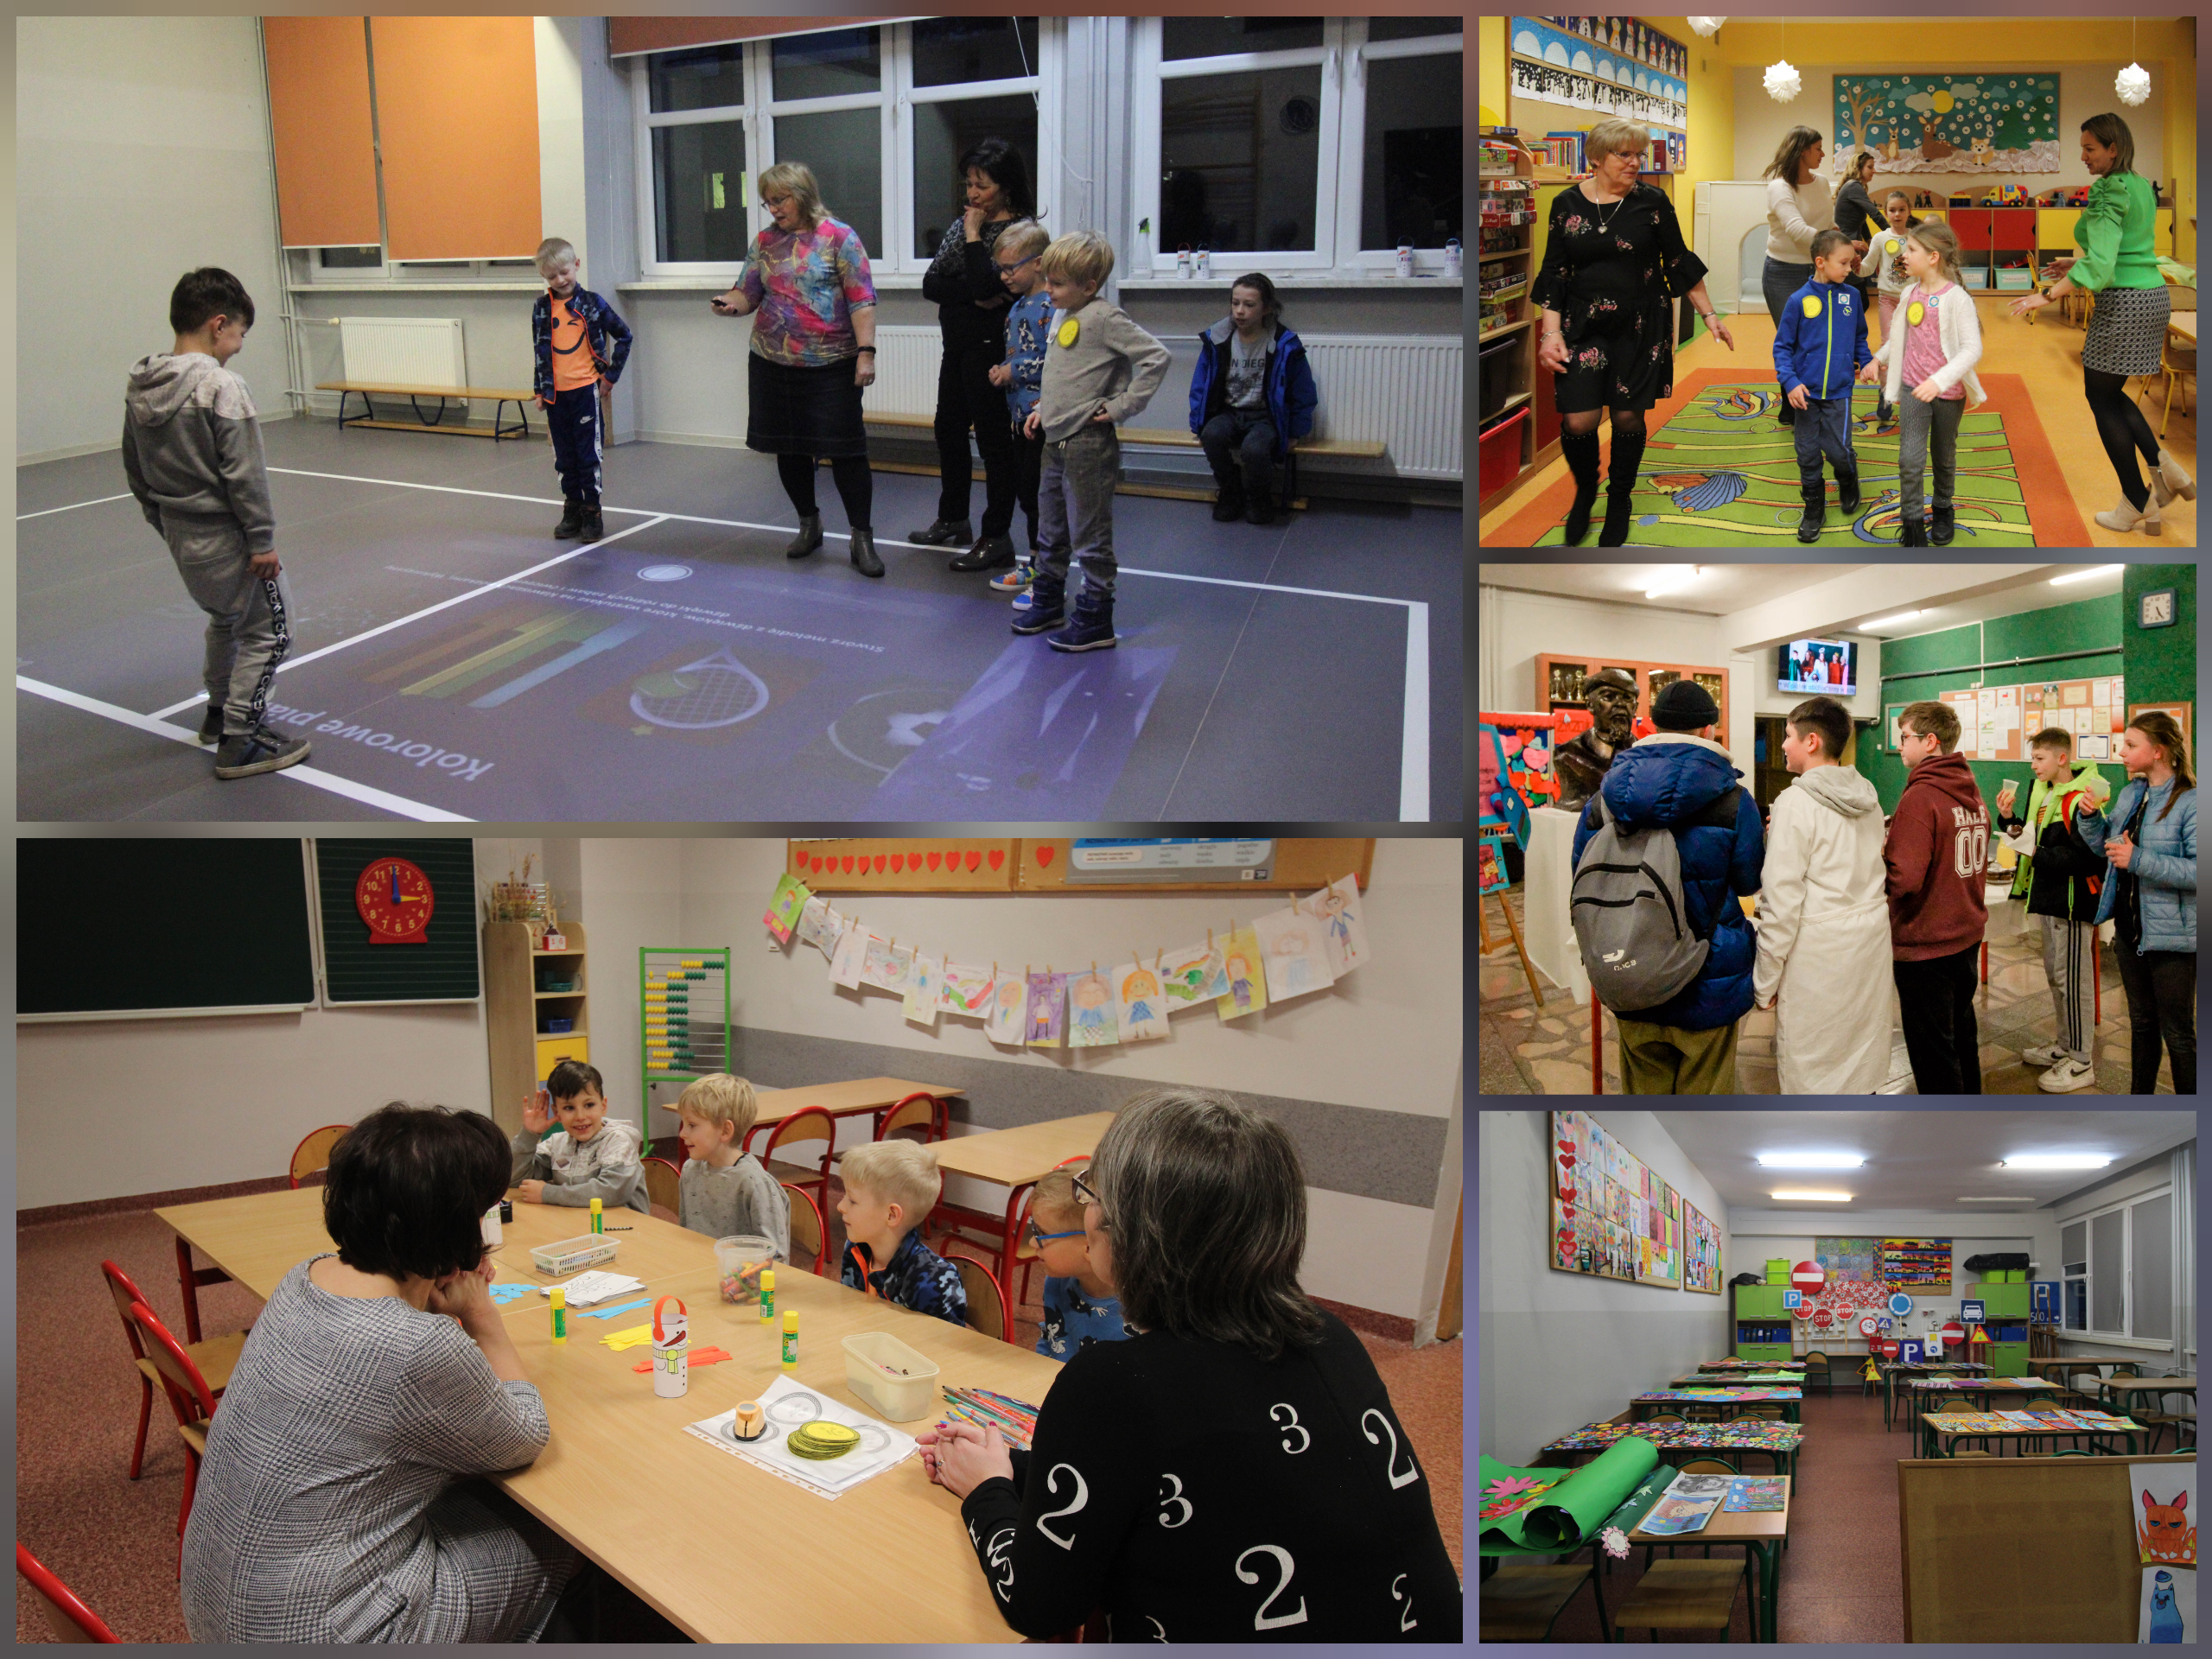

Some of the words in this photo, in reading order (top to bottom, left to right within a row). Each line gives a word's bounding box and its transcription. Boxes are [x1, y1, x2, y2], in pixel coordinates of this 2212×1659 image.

[1242, 358, 1265, 368] DIEG
[315, 719, 495, 782] Kolorowe
[1951, 804, 1987, 828] HALE
[374, 870, 385, 880] 11
[388, 865, 400, 875] 12
[405, 870, 411, 880] 1
[365, 880, 378, 891] 10
[416, 881, 423, 891] 2
[363, 894, 371, 905] 9
[421, 894, 428, 904] 3
[370, 909, 377, 919] 8
[417, 909, 424, 918] 4
[381, 919, 388, 929] 7
[395, 923, 402, 932] 6
[409, 919, 416, 929] 5
[1789, 1294, 1798, 1306] P
[1904, 1343, 1918, 1361] P
[1269, 1402, 1311, 1454] 3
[1361, 1408, 1420, 1491] 2
[1159, 1473, 1193, 1529] 3
[1036, 1463, 1089, 1551] 2
[1235, 1544, 1308, 1630] 2
[1392, 1573, 1417, 1633] 2
